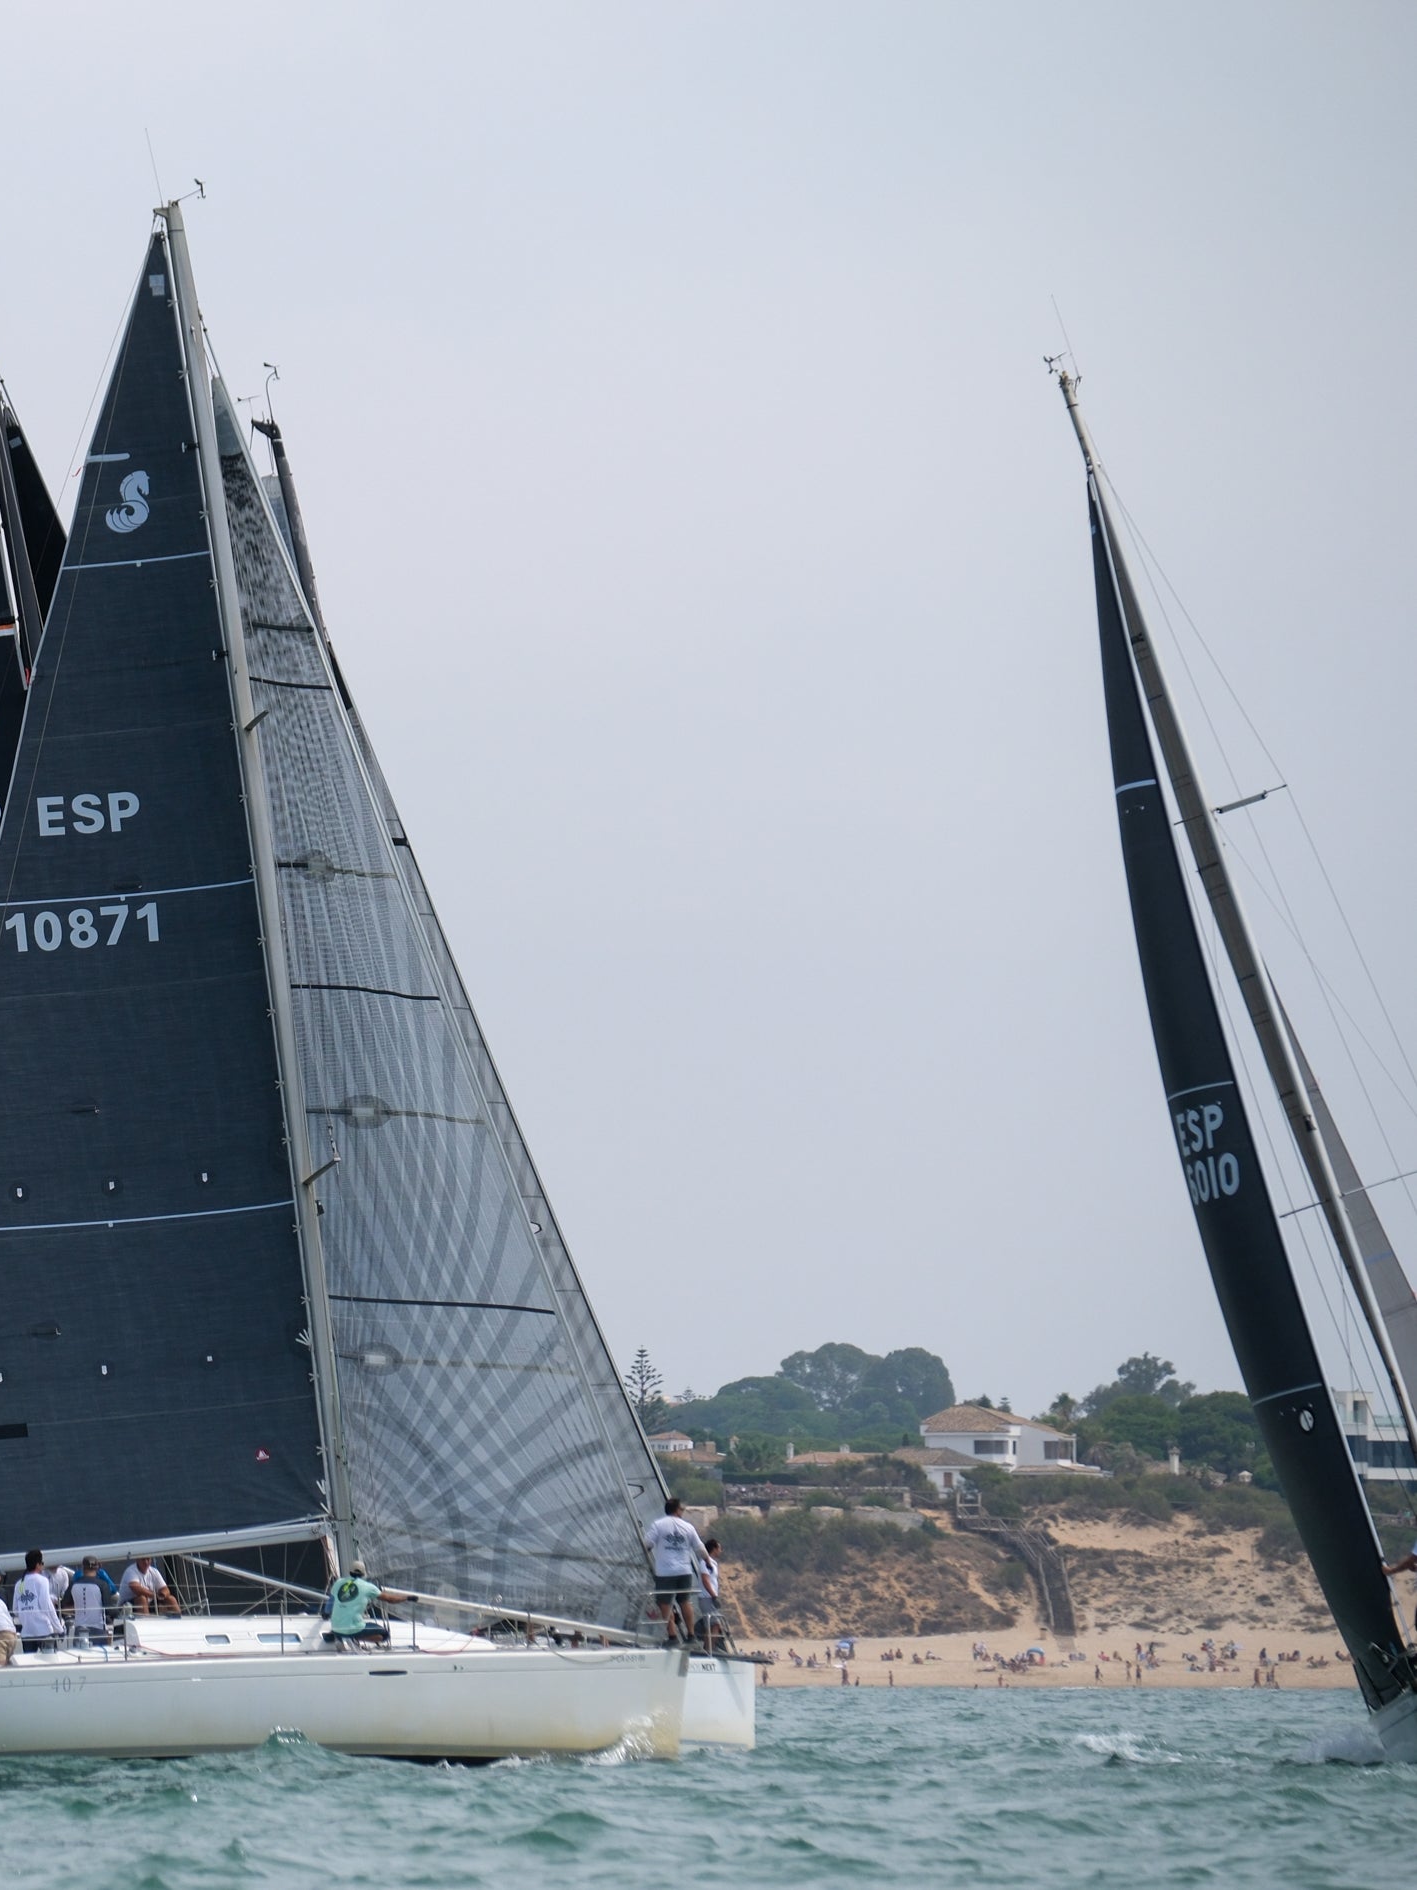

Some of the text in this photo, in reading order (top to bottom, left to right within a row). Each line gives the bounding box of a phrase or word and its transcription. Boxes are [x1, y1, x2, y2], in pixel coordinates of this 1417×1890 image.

[36, 791, 140, 837] ESP
[4, 902, 160, 953] 10871
[1175, 1104, 1224, 1157] ESP
